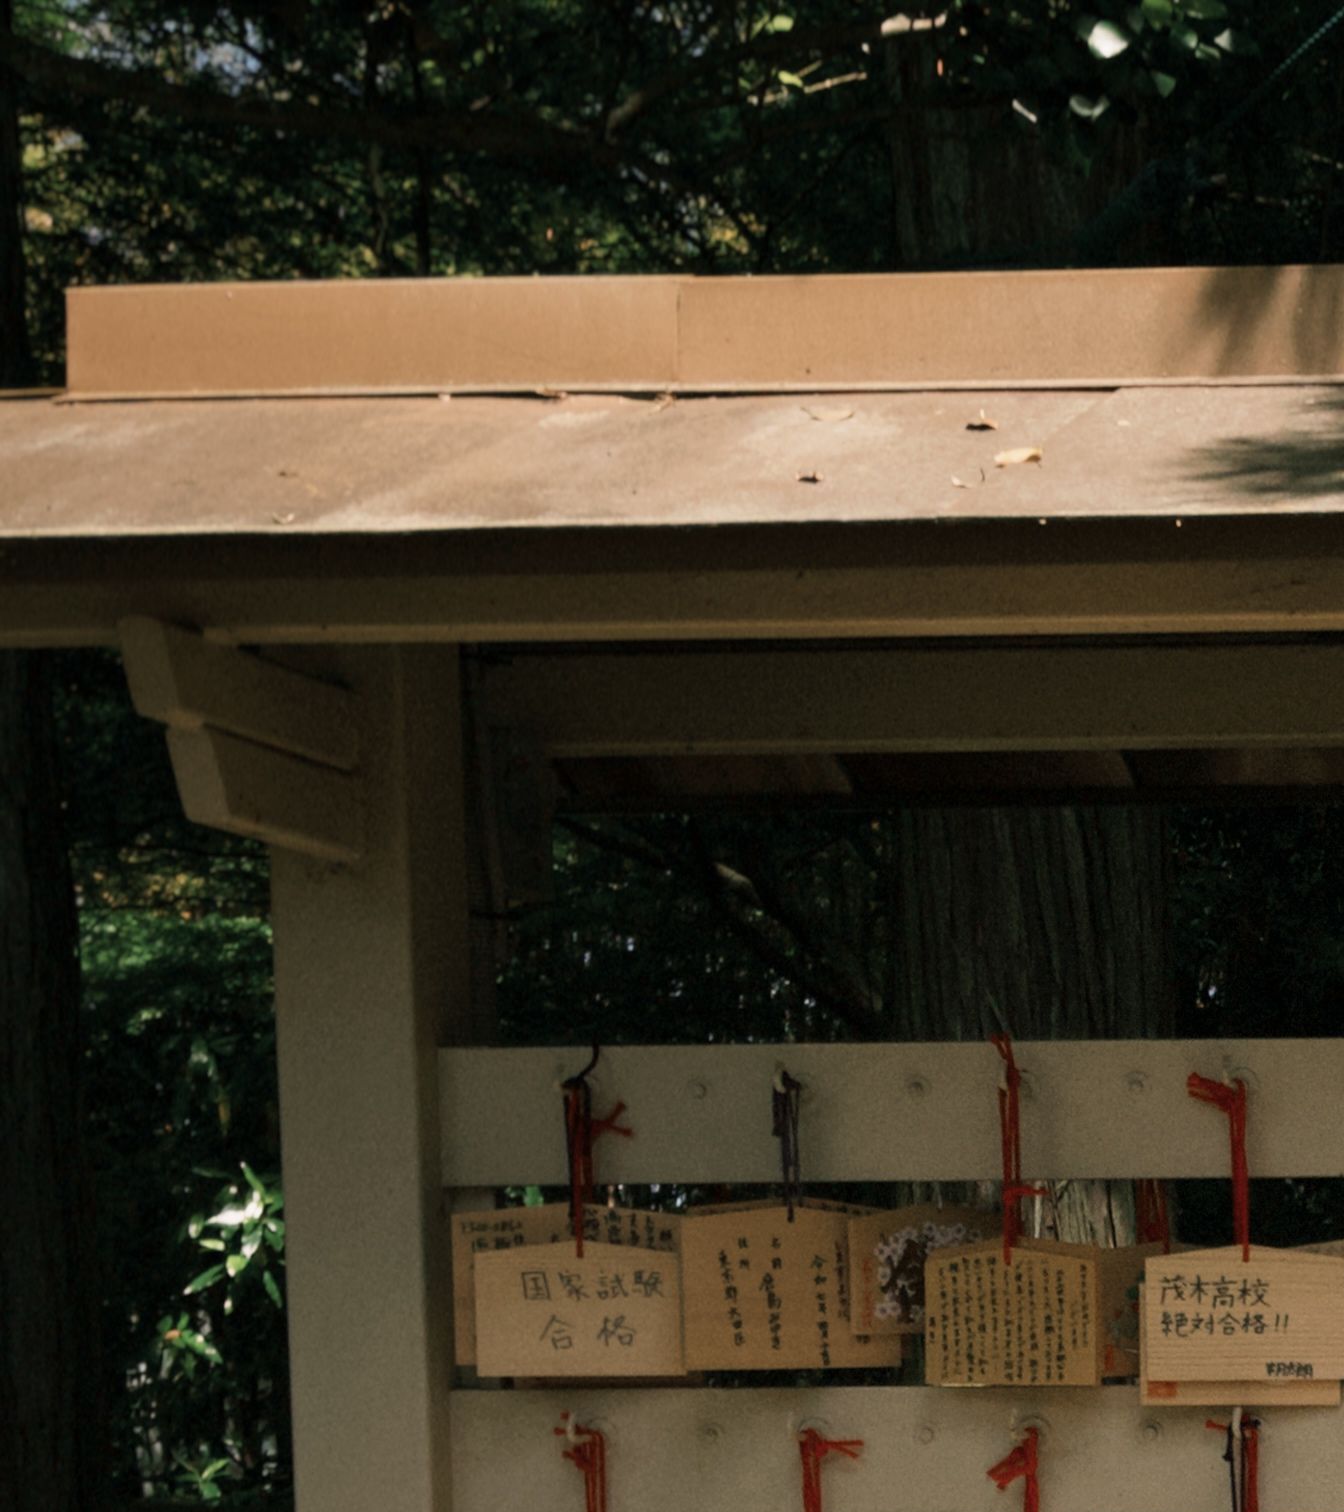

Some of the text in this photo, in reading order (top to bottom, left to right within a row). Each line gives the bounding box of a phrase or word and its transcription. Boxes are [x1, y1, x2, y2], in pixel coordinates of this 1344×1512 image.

[521, 1271, 664, 1303] 国家試験
[1160, 1275, 1272, 1308] 茂木高校
[540, 1315, 637, 1351] 合格
